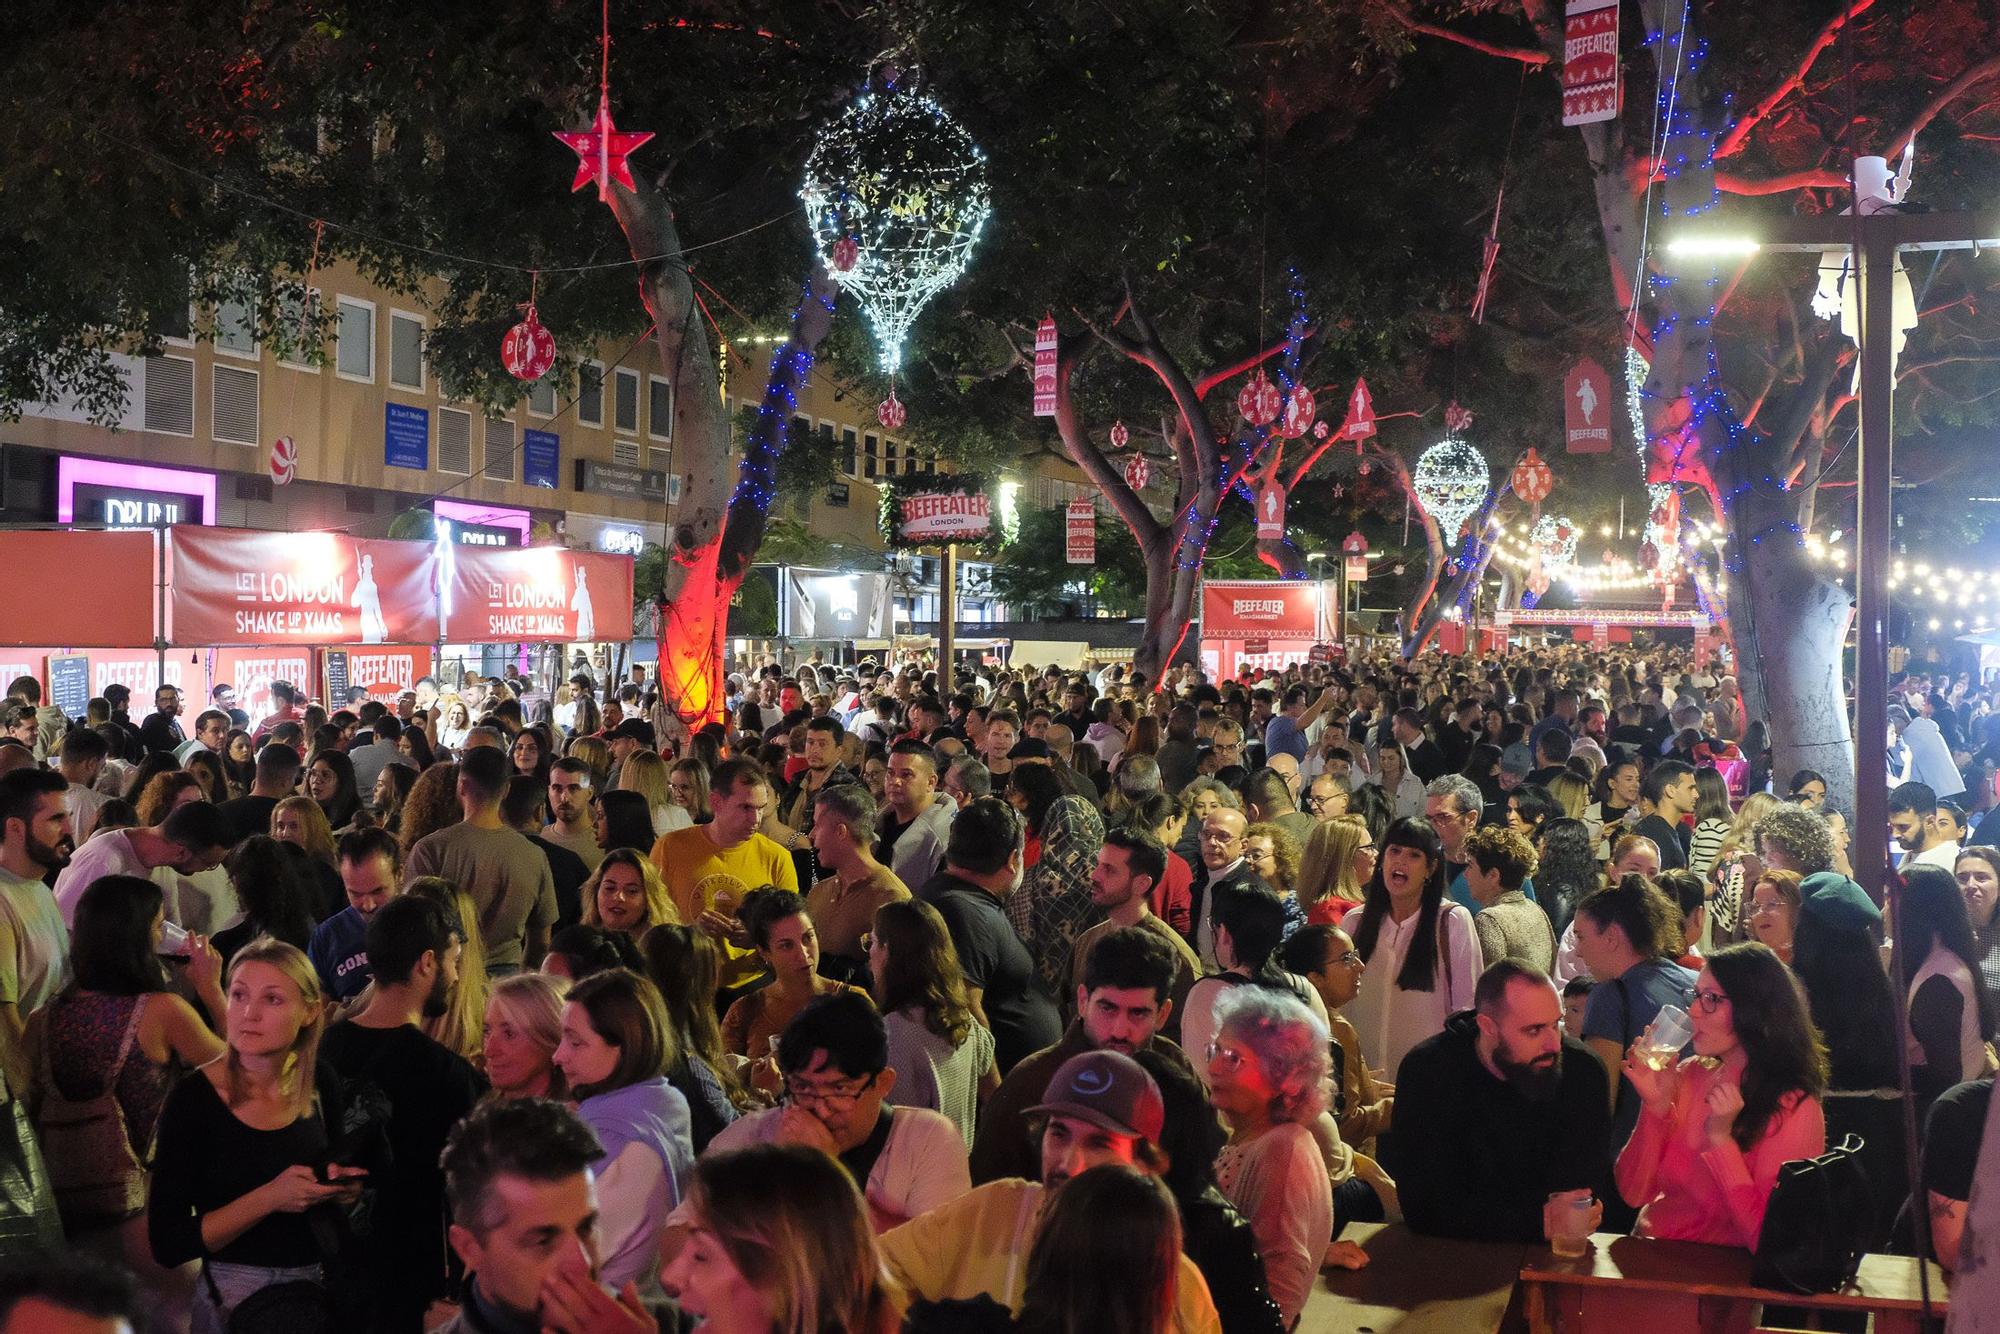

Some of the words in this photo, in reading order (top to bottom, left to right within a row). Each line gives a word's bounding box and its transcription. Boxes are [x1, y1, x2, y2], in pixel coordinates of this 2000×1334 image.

[1565, 31, 1616, 65] BEEFEATER
[1570, 428, 1607, 442] BEEFEATER
[902, 494, 989, 524] BEEFEATER
[931, 518, 964, 526] LONDON
[236, 572, 256, 592] LET
[261, 571, 344, 604] LONDON
[489, 583, 503, 599] LET
[505, 582, 566, 609] LONDON
[1233, 600, 1284, 616] BEEFEATER
[236, 610, 286, 634] SHAKE
[287, 611, 303, 628] UP
[304, 611, 344, 634] XMAS
[489, 614, 524, 635] SHAKE
[525, 615, 537, 629] UP
[537, 615, 566, 635] XMAS
[350, 655, 414, 690] BEEFEATER
